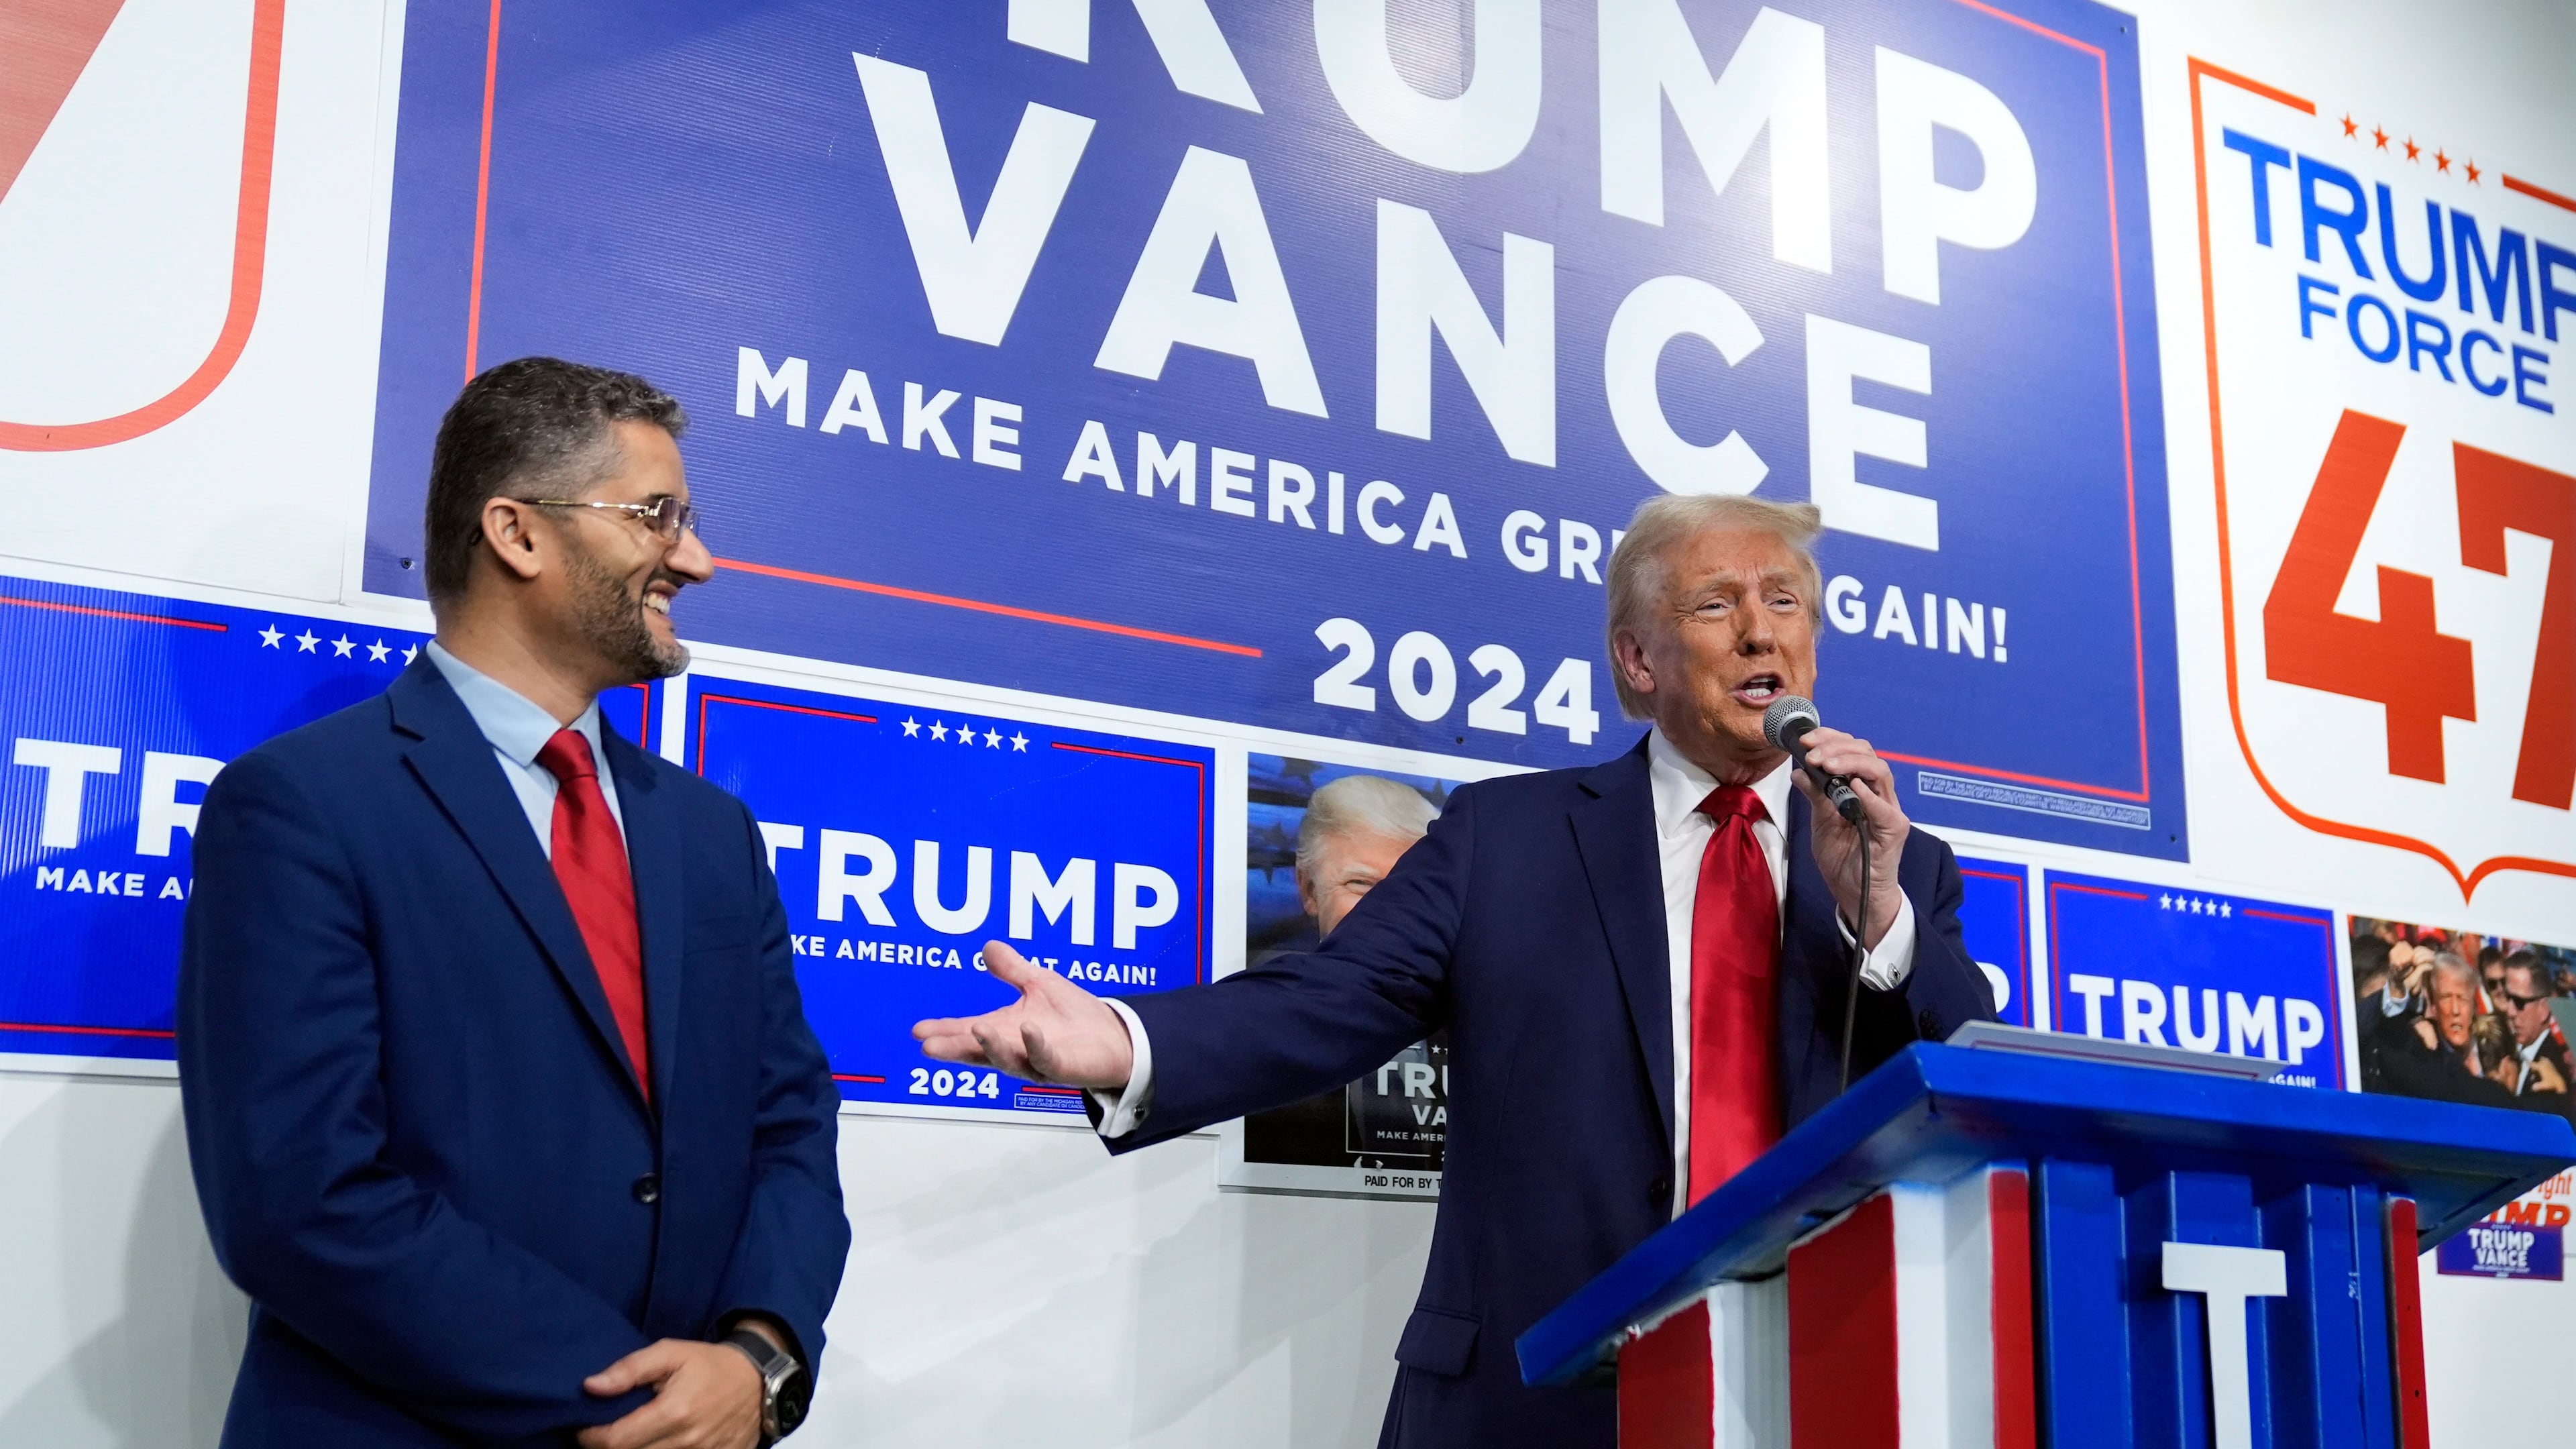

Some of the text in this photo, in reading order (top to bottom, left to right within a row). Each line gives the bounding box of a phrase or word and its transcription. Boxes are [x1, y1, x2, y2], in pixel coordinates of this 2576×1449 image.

[851, 51, 1940, 551] VANCE
[2296, 274, 2555, 415] FORCE
[735, 345, 1022, 471] MAKE
[1061, 419, 1468, 559] AMERICA
[1825, 574, 2007, 663] GAIN!
[2263, 408, 2576, 810] 47
[1313, 617, 1599, 745] 2024
[13, 737, 227, 857] TR
[36, 866, 145, 897] MAKE
[790, 934, 825, 957] KE
[835, 938, 963, 969] AMERICA
[1067, 960, 1157, 986] AGAIN!
[2070, 973, 2324, 1065] TRUMP
[909, 1067, 1000, 1099] 2024
[1377, 1130, 1409, 1140] MAKE
[1364, 1175, 1389, 1187] PAID
[1392, 1177, 1414, 1188] FOR
[1418, 1178, 1433, 1189] BY
[2468, 1228, 2535, 1251] TRUMP
[2475, 1248, 2528, 1267] VANCE
